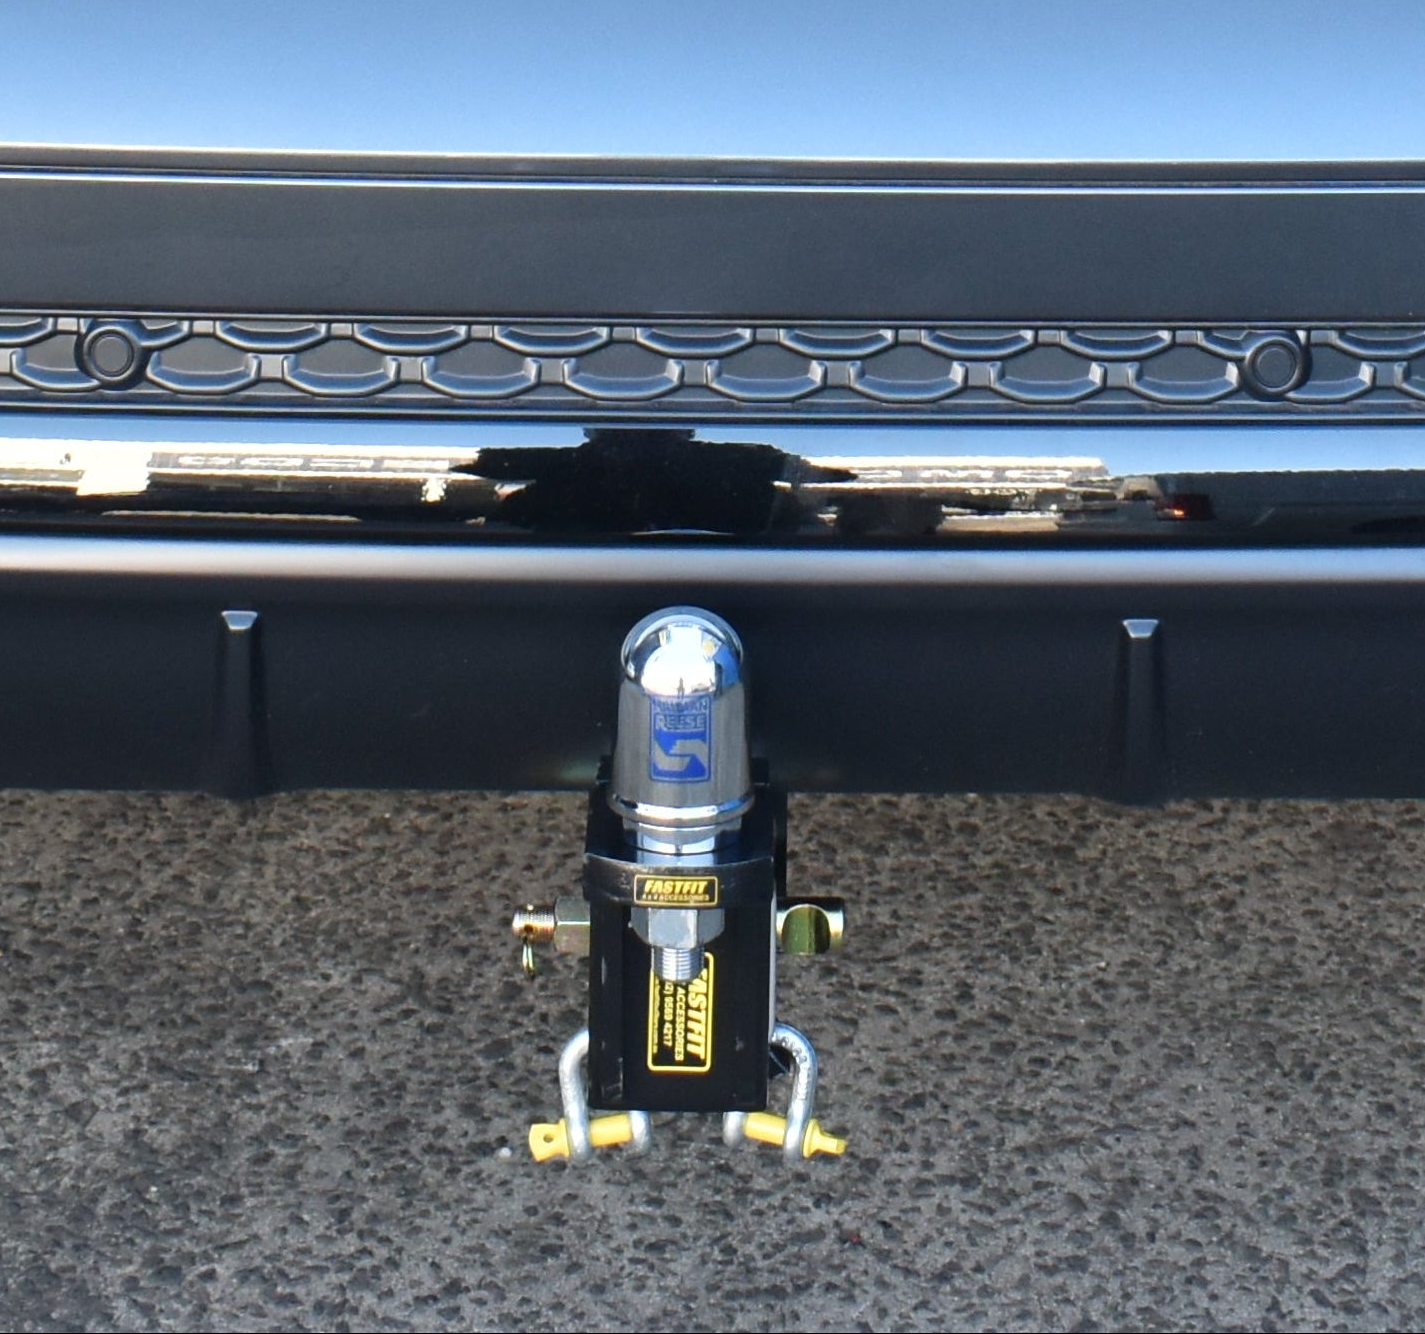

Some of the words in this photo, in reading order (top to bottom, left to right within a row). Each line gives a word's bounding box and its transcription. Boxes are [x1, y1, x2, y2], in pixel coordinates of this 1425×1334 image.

[644, 879, 708, 894] FASTFIT
[662, 1021, 673, 1047] 4217
[675, 986, 686, 1061] ACCESSORIES
